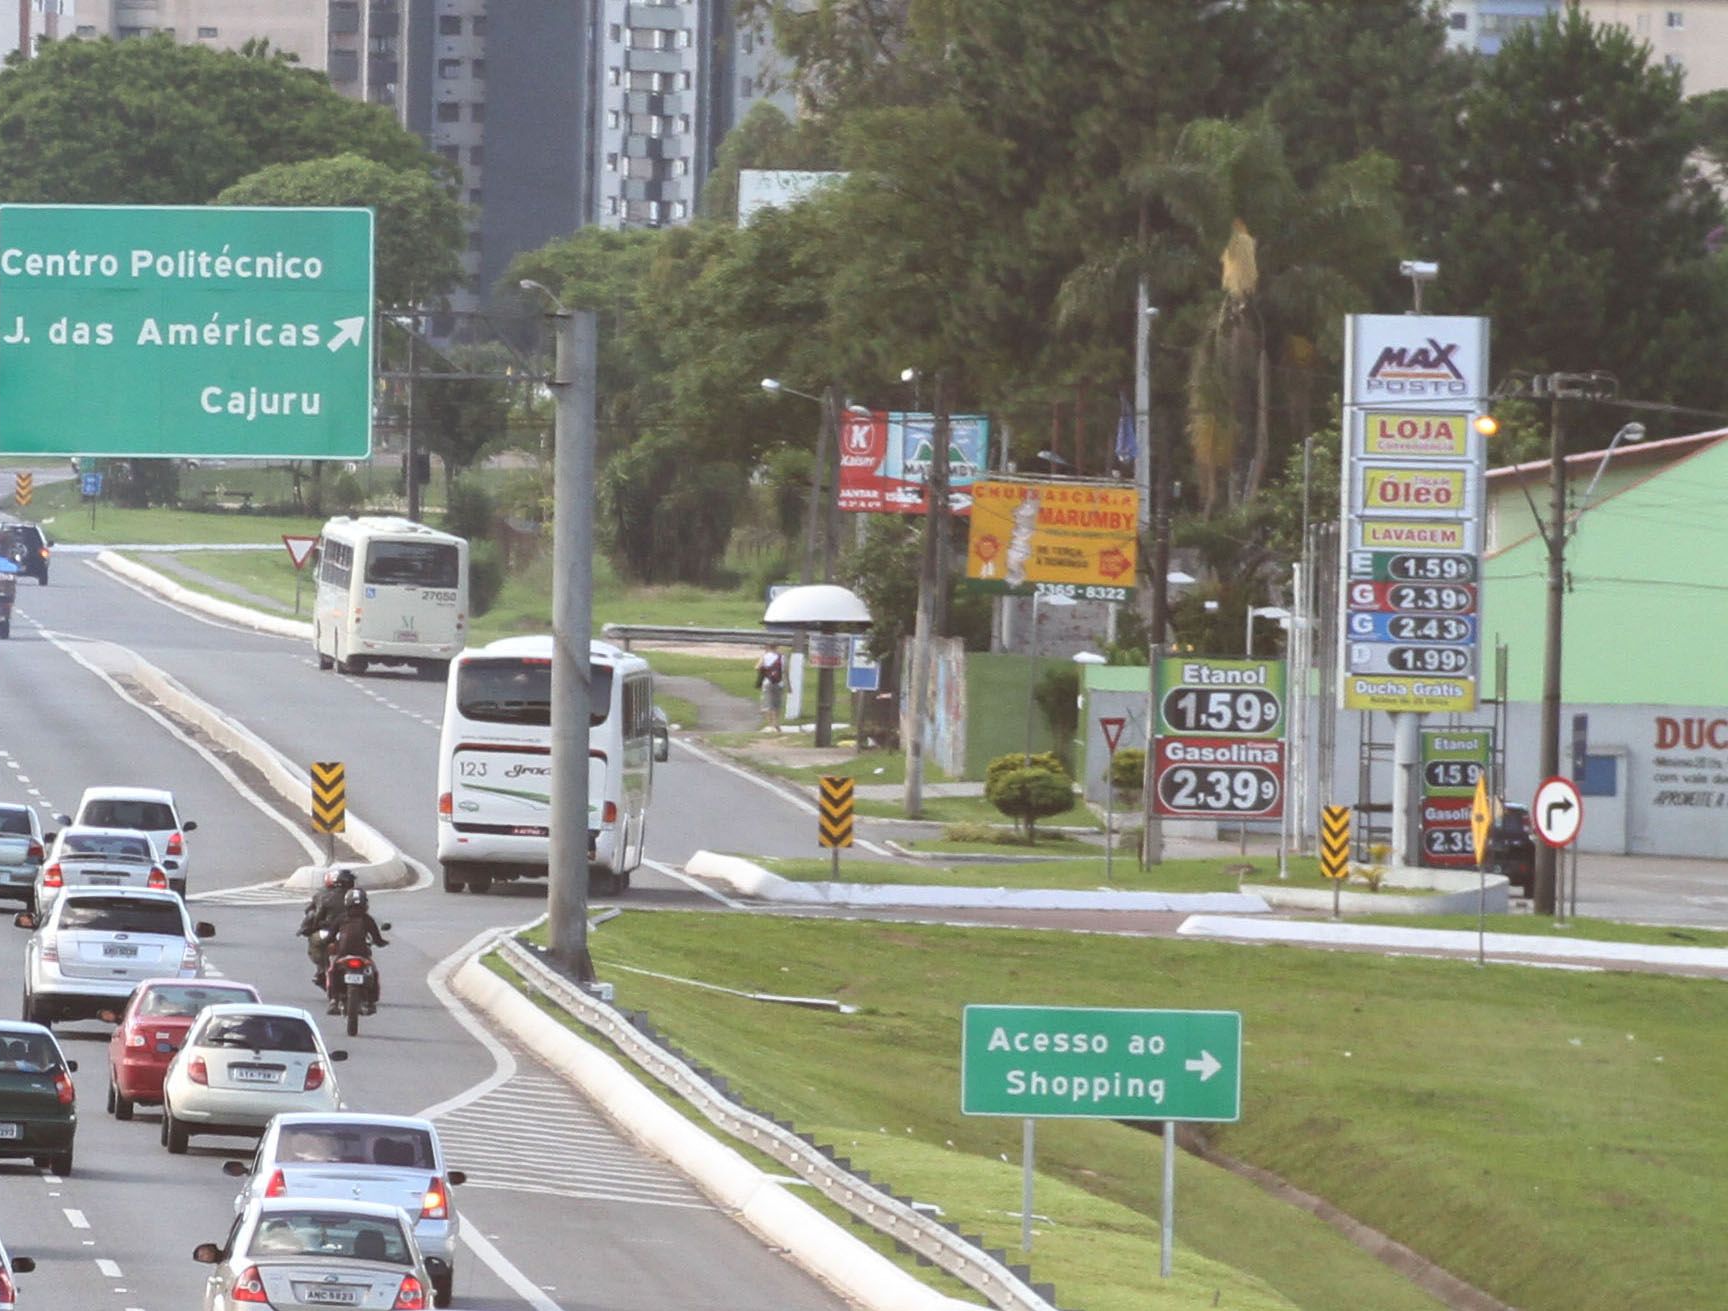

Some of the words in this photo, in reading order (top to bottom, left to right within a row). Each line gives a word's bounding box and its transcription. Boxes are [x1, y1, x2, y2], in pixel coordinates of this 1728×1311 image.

[1, 248, 119, 278] Centro
[130, 243, 323, 280] Politécnico
[3, 317, 31, 345] J.
[49, 317, 114, 346] das
[136, 312, 321, 348] Américas
[1366, 379, 1468, 395] POSTO
[200, 387, 321, 422] Cajuru
[1379, 419, 1454, 441] LOJA
[1379, 474, 1452, 504] Óleo
[1371, 528, 1457, 543] LAVAGEM
[1351, 553, 1373, 573] E
[1351, 584, 1375, 604] G
[1351, 614, 1374, 634] G
[1183, 664, 1266, 684] Etanol
[1355, 681, 1407, 695] Ducha
[1654, 716, 1728, 750] DUC
[1165, 741, 1279, 763] Gasolina
[1433, 737, 1479, 751] Etanol
[459, 762, 488, 777] 123
[504, 764, 552, 778] grac
[1424, 807, 1473, 821] Gasoli
[987, 1027, 1109, 1053] Acesso
[1128, 1035, 1166, 1055] ao
[1006, 1070, 1166, 1105] Shopping
